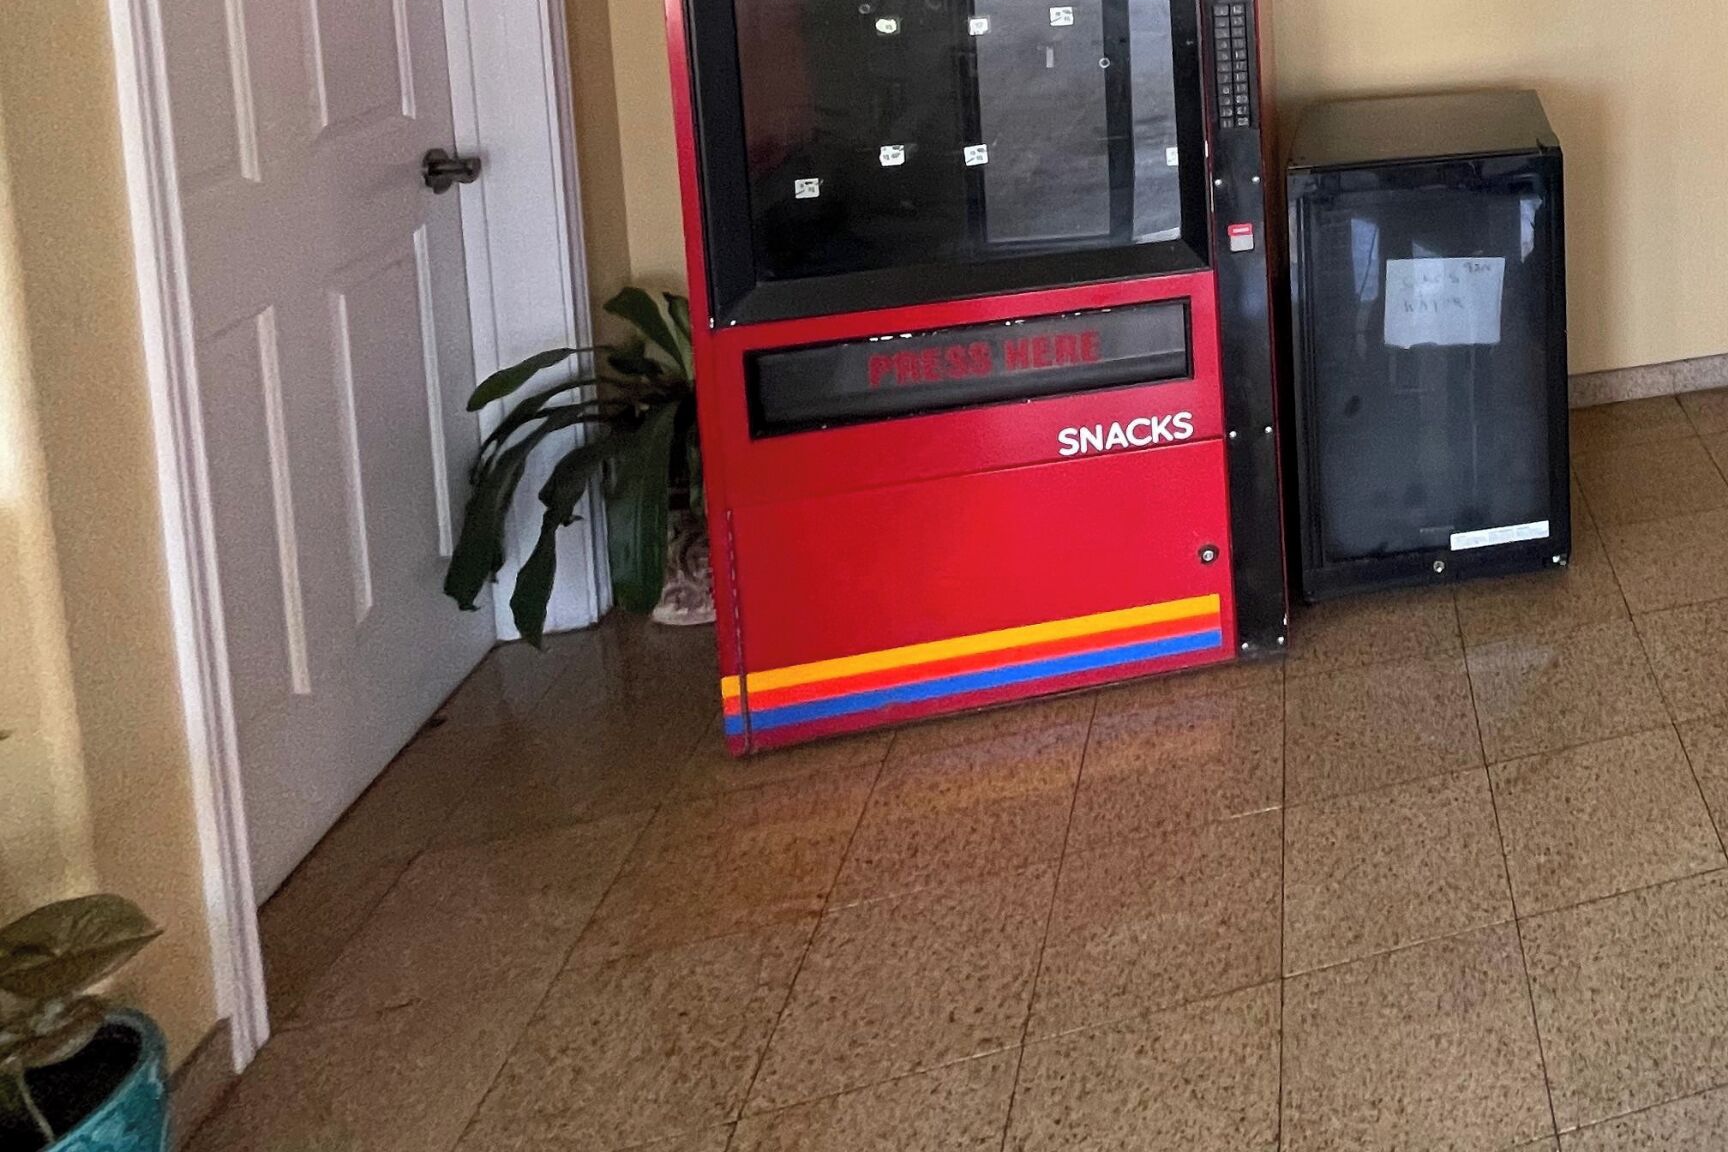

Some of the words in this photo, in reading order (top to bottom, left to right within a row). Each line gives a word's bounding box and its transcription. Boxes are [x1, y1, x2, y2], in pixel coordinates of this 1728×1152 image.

[867, 341, 993, 390] PRESS
[1003, 330, 1102, 372] HERE
[1057, 411, 1195, 457] SNACKS
